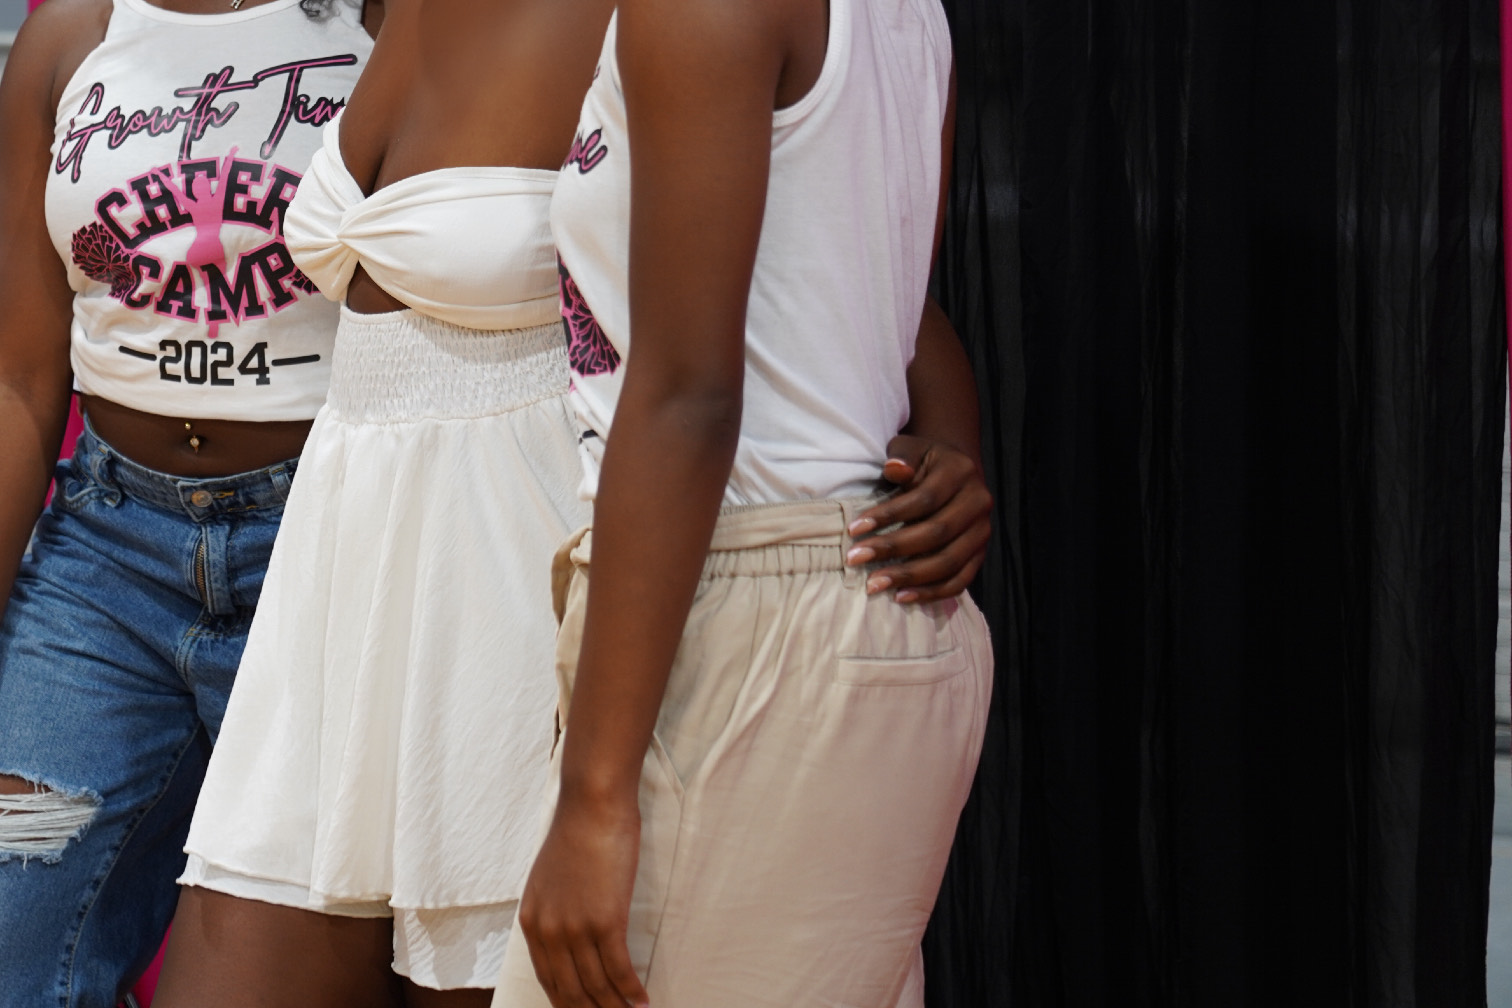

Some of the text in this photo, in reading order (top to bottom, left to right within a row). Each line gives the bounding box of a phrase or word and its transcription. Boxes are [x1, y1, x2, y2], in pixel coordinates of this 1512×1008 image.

[55, 54, 358, 184] Growth Tim
[123, 239, 299, 327] CAMP
[159, 339, 271, 387] 2024
